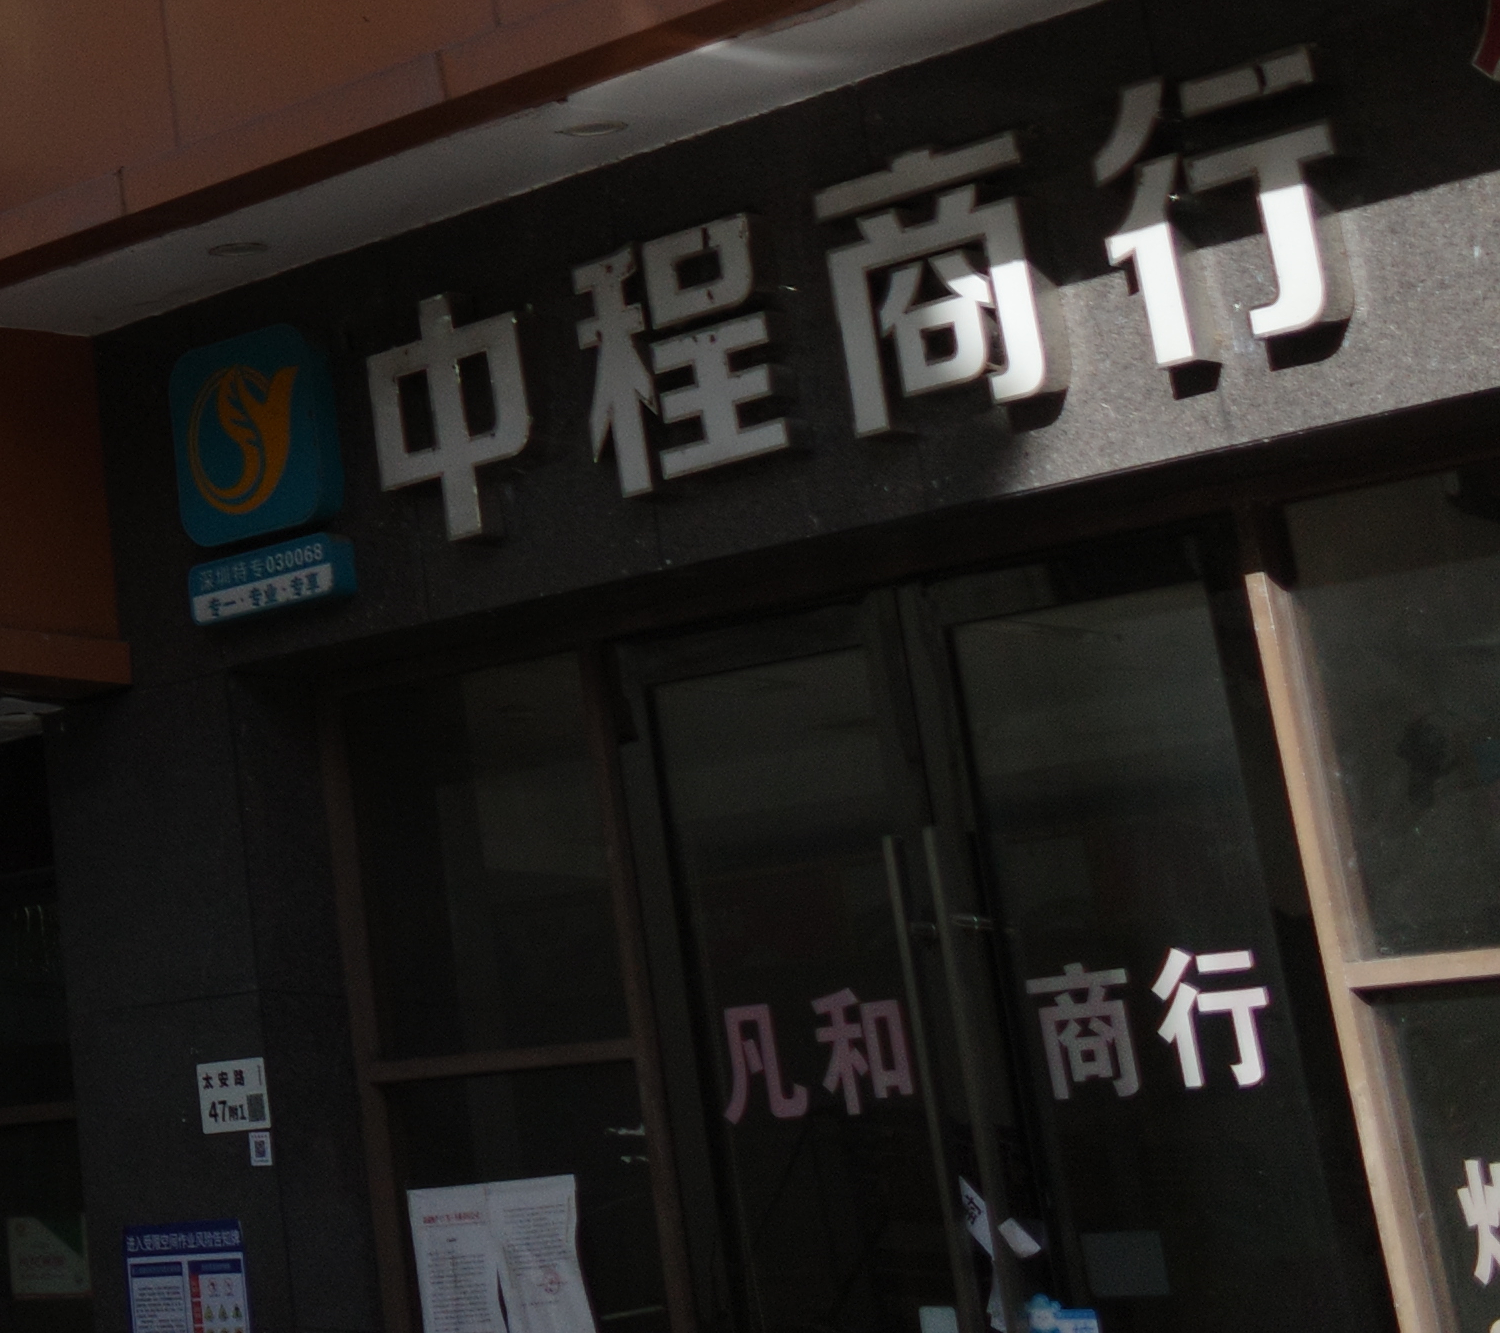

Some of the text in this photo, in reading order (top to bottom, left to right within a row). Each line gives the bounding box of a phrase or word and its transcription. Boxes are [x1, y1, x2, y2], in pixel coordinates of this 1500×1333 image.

[366, 42, 1336, 543] 中程商行
[202, 1068, 245, 1090] 太安路
[723, 946, 1270, 1126] 凡和 商行
